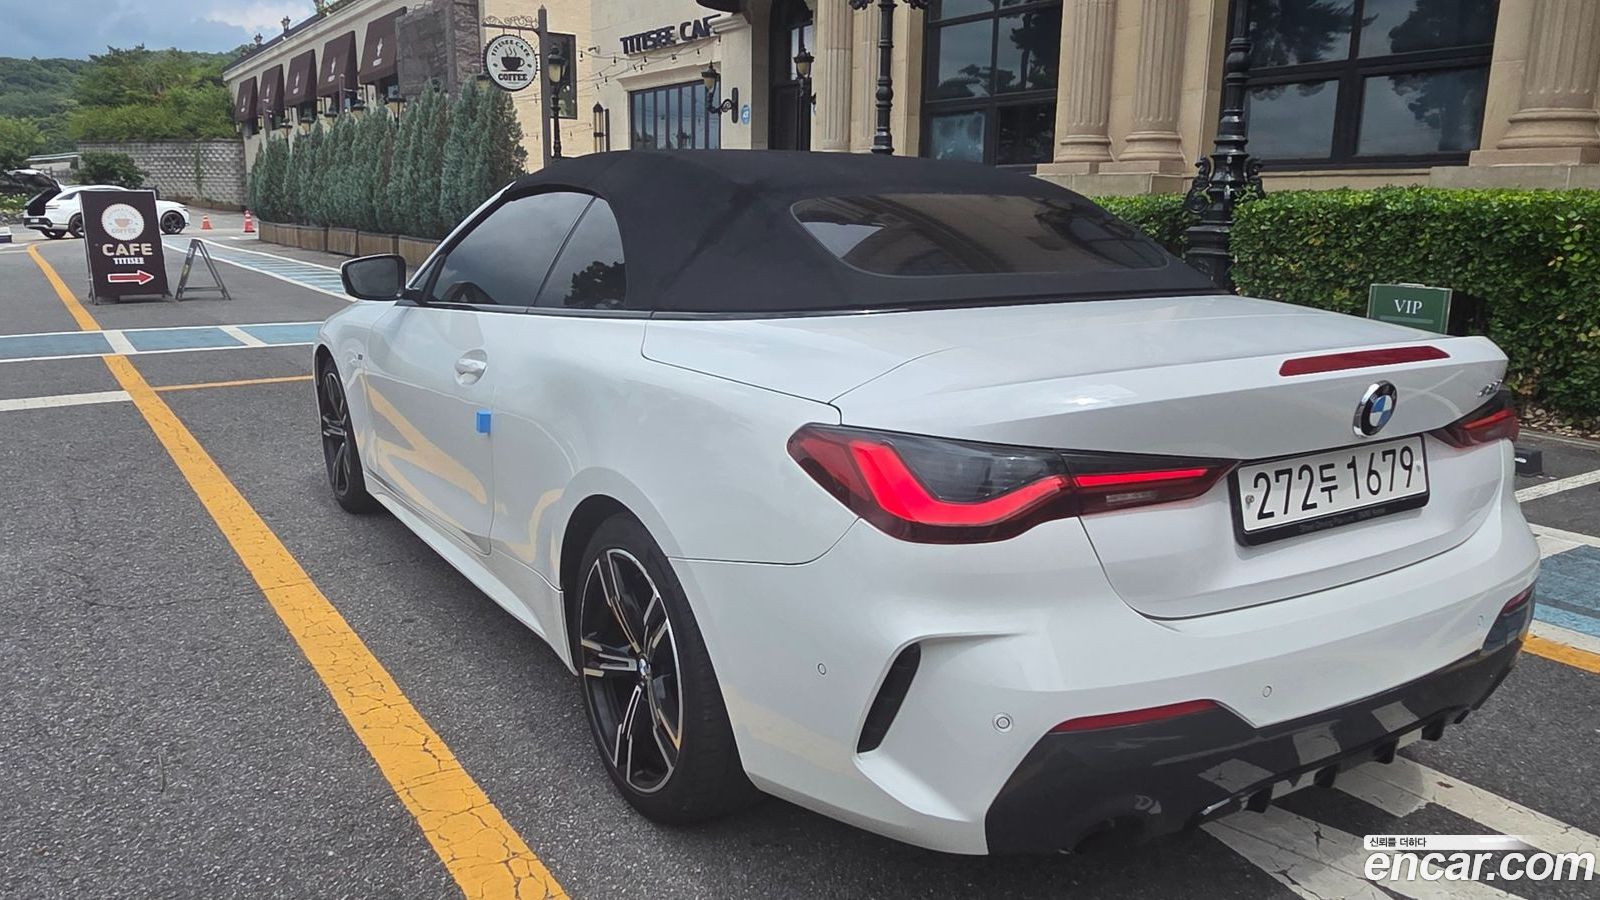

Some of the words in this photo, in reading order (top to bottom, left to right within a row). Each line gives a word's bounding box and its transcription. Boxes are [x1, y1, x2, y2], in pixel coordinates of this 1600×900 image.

[497, 73, 528, 81] COFFEE
[102, 243, 153, 256] CAFE
[1394, 299, 1423, 315] VIP
[1253, 462, 1339, 521] 272두
[1346, 445, 1414, 500] 1679
